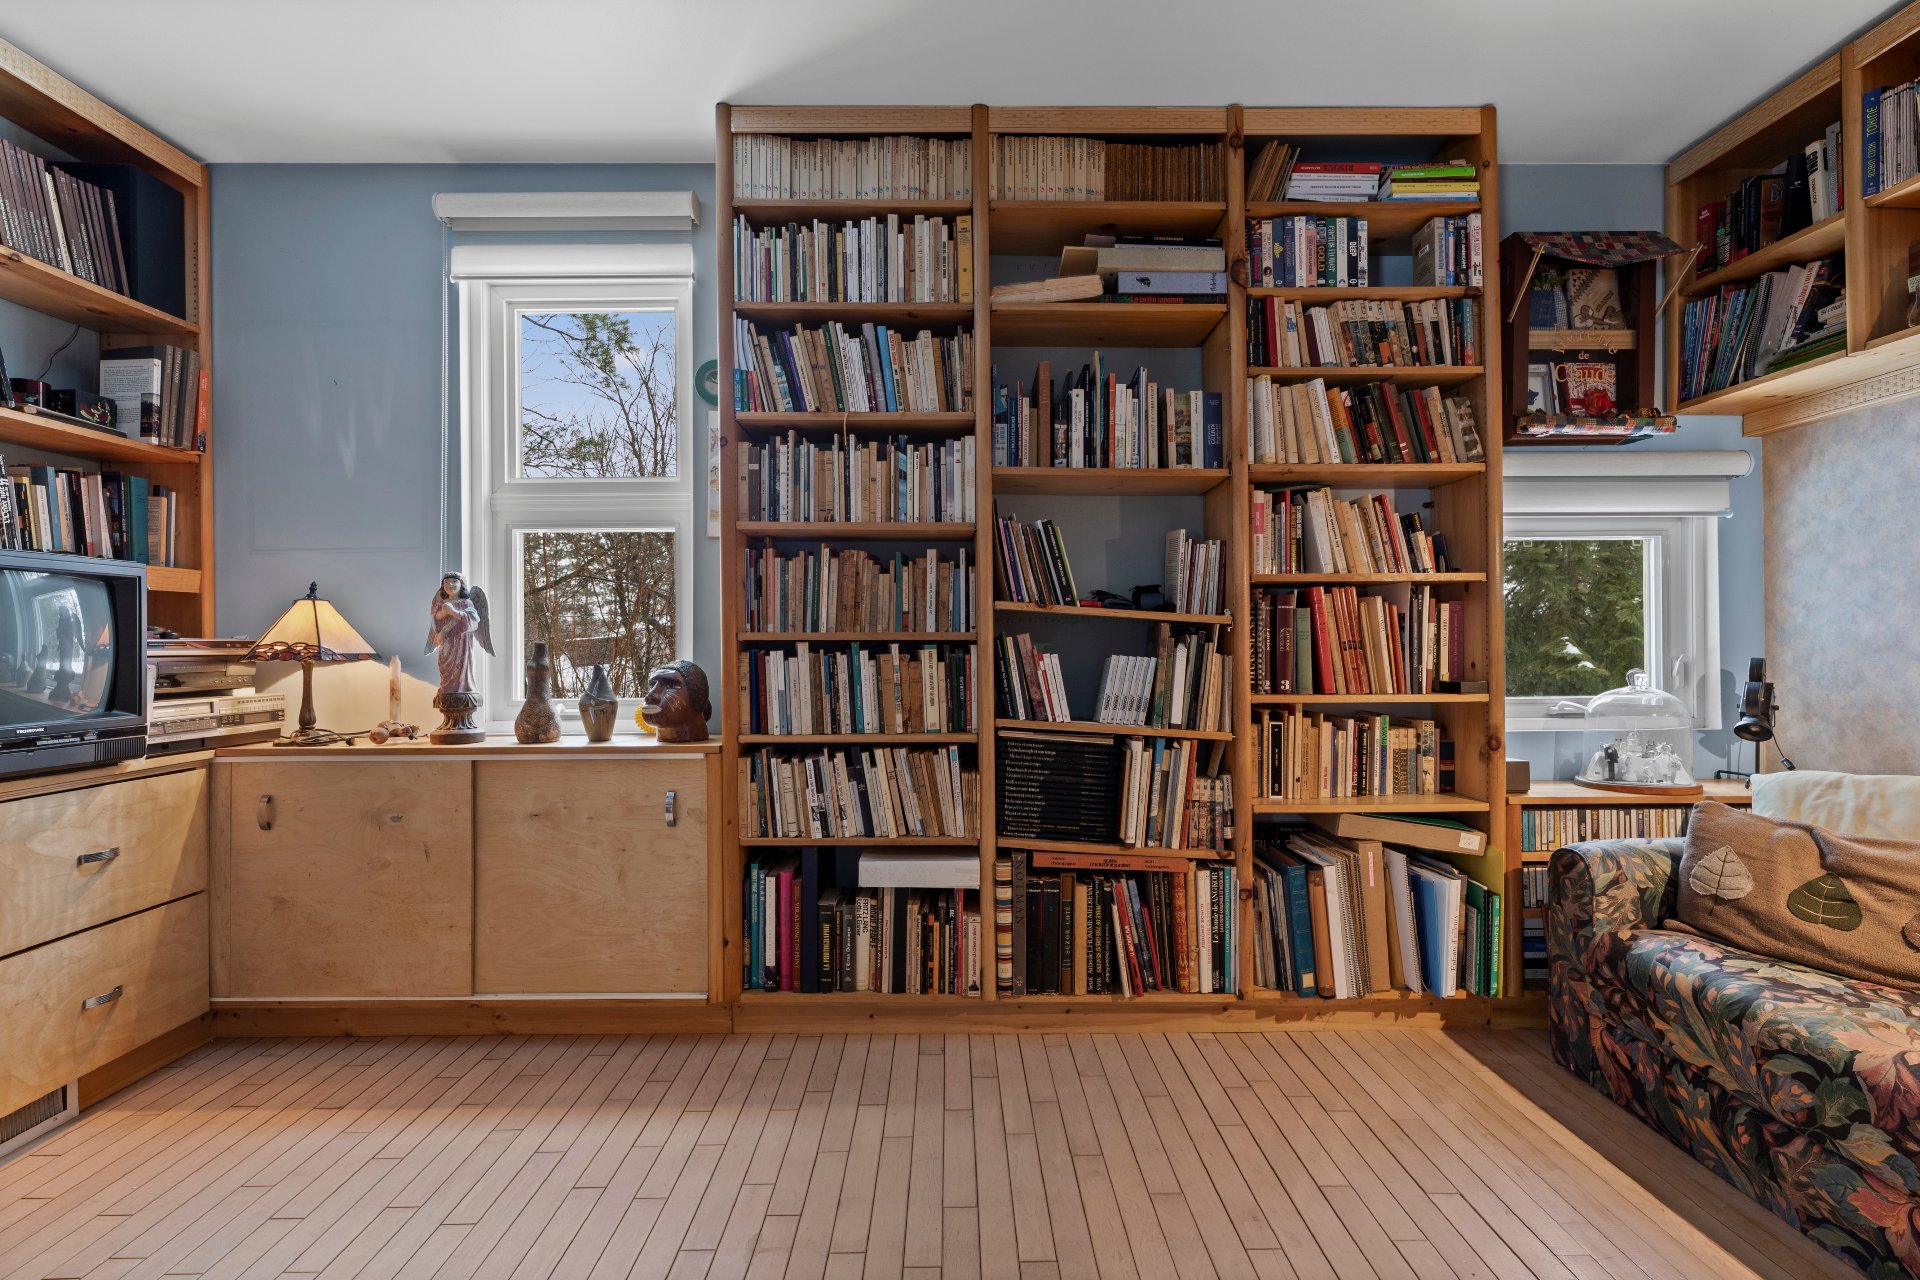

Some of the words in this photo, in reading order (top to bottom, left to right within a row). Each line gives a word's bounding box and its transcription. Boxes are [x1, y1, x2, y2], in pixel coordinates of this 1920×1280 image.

[1317, 245, 1326, 271] GOLD
[1578, 351, 1589, 360] de
[1555, 364, 1617, 382] Claude
[1016, 860, 1024, 924] NOTMAN
[1211, 872, 1219, 903] ANGKOR
[1212, 903, 1219, 912] de
[1212, 935, 1219, 943] Le
[1450, 945, 1458, 971] Enfants
